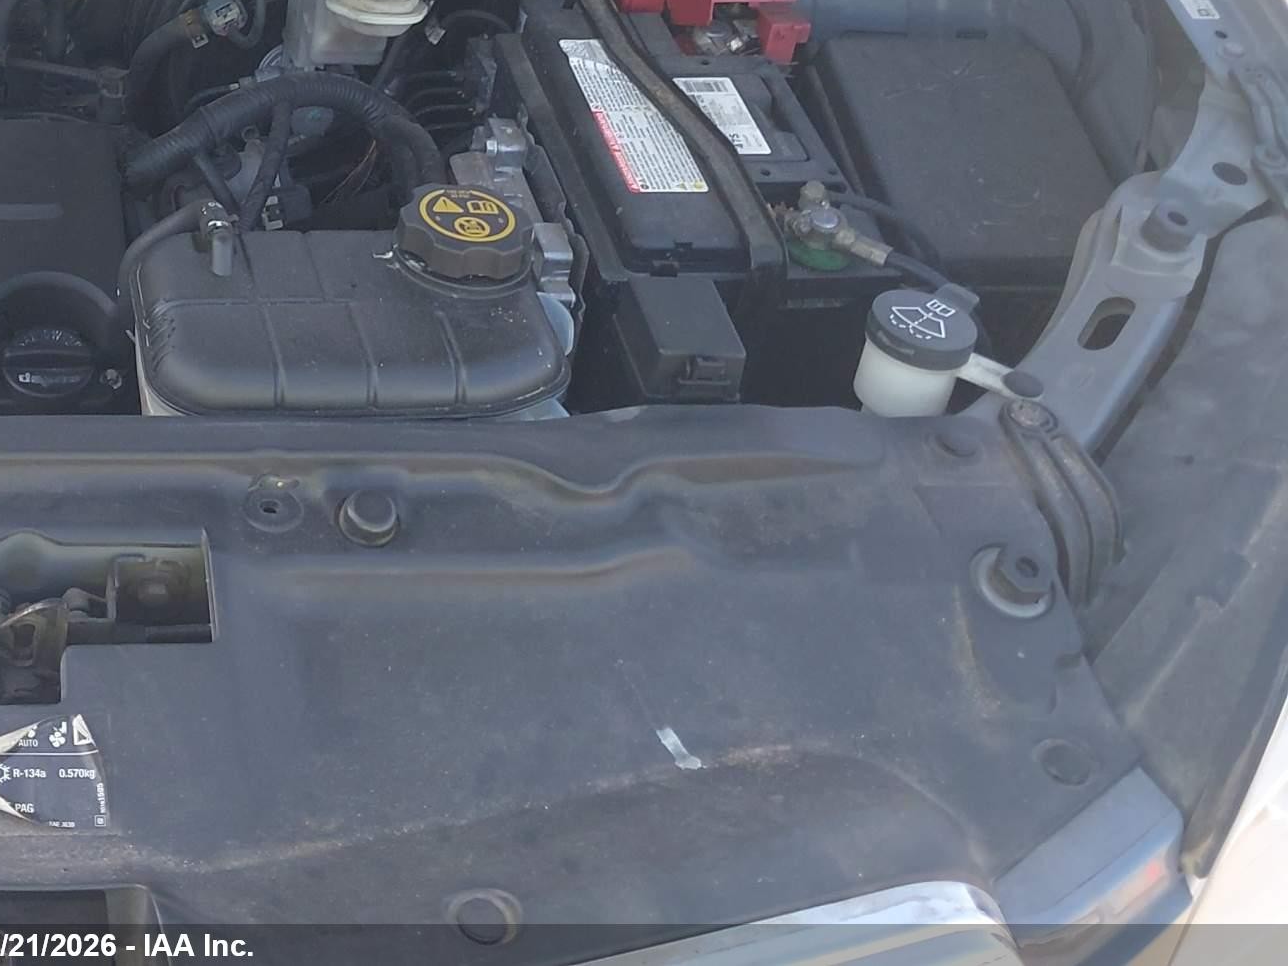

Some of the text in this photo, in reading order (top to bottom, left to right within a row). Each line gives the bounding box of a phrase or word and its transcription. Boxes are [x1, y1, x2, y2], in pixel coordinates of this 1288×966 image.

[18, 738, 39, 747] AUTO
[12, 768, 96, 780] R-134a 0.570kg
[14, 803, 35, 814] PAG
